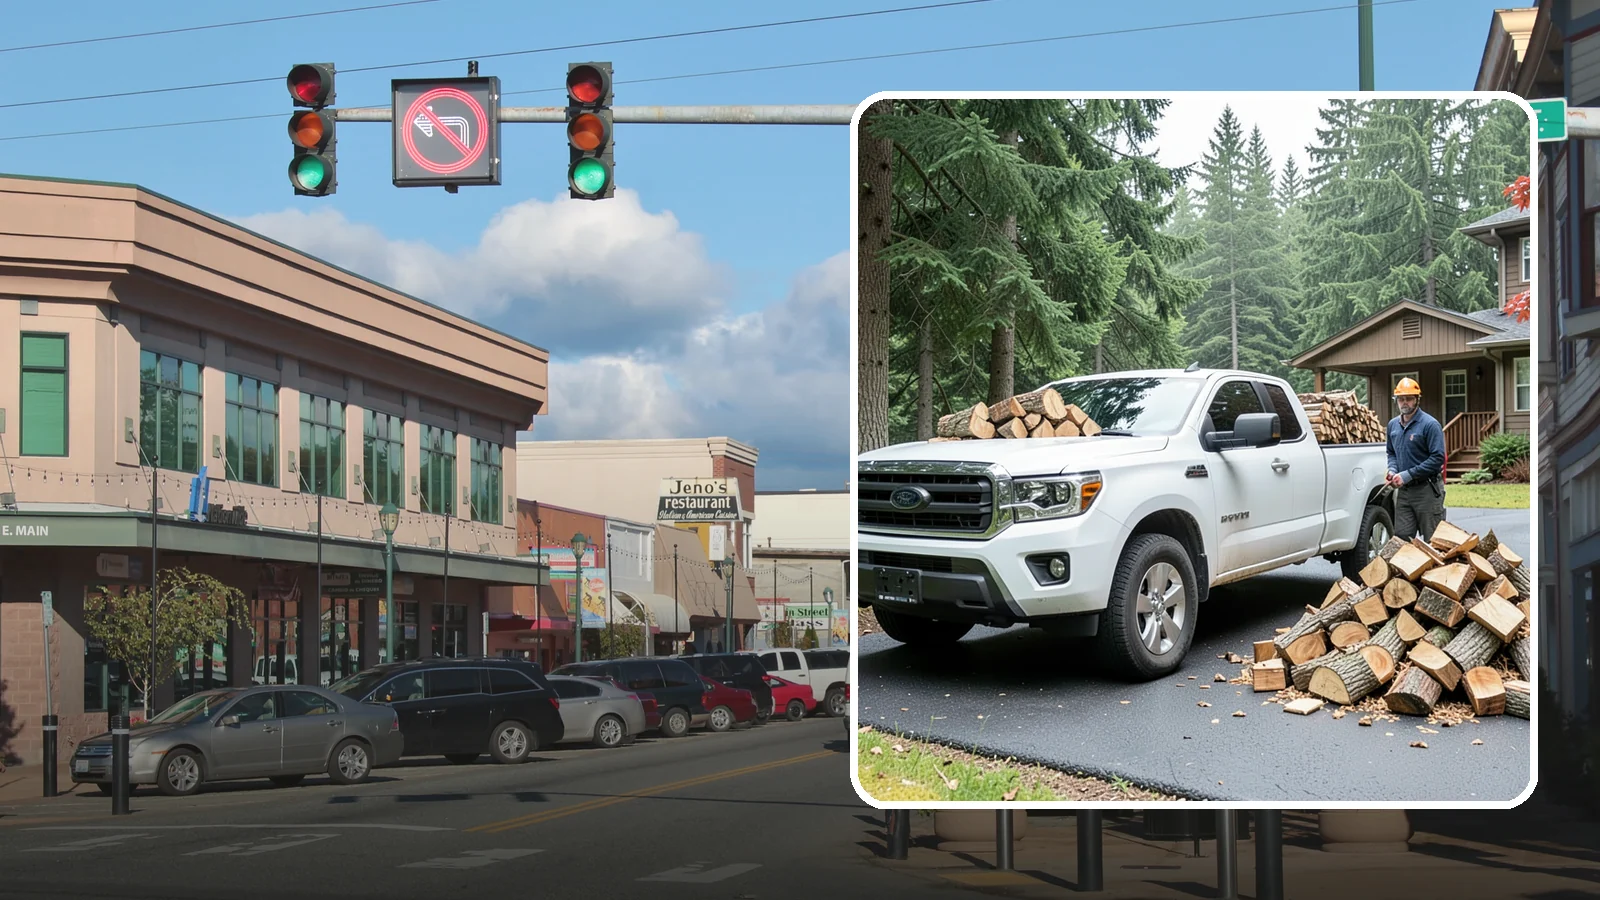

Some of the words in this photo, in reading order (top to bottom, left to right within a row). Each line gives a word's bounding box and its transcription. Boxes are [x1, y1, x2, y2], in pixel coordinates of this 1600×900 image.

[669, 480, 727, 494] Jeno's
[665, 496, 731, 509] restaurant
[686, 509, 715, 519] American
[715, 509, 738, 519] Cuisine
[2, 525, 13, 536] E.
[15, 525, 49, 536] MAIN
[797, 607, 828, 617] Street
